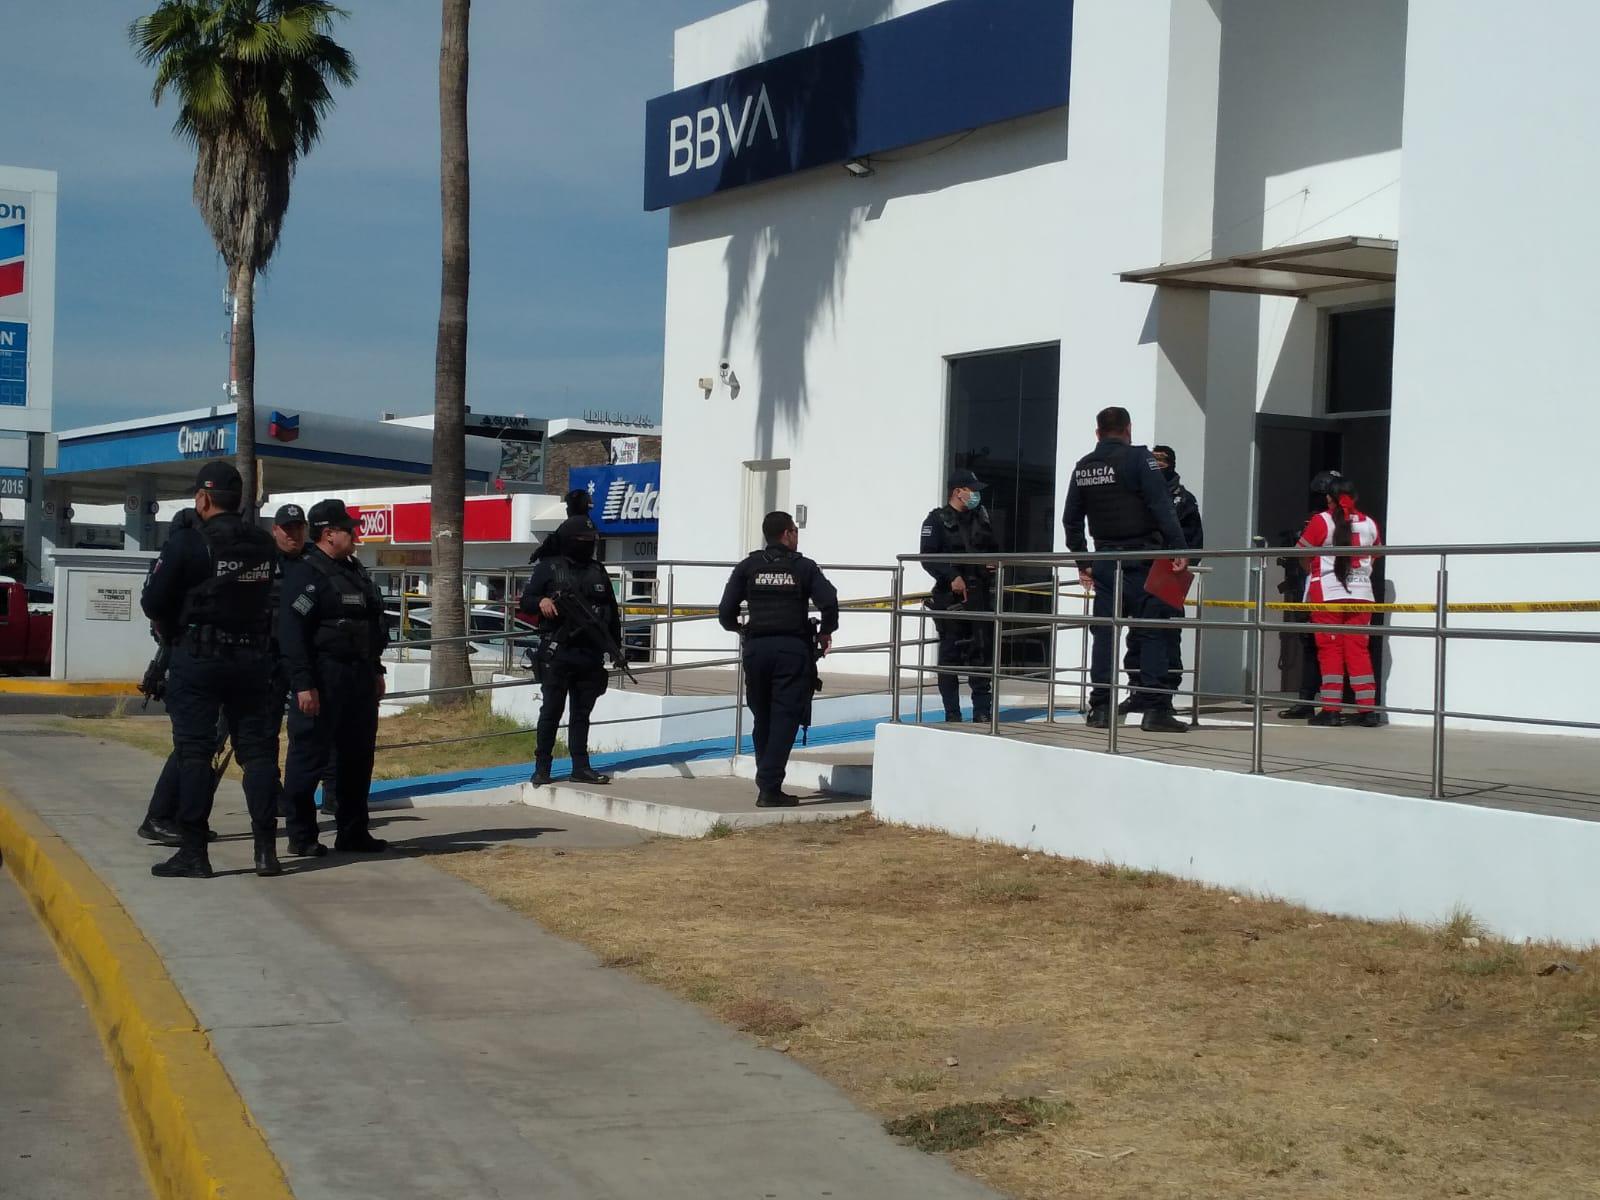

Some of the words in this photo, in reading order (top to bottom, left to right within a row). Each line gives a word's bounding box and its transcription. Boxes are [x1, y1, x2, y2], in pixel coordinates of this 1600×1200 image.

[669, 82, 778, 177] BBVA
[178, 425, 225, 454] Chevron
[1075, 466, 1115, 478] POLICÍA
[1, 479, 24, 495] 2015
[1076, 475, 1116, 487] MUNICIPAL
[634, 542, 657, 556] con
